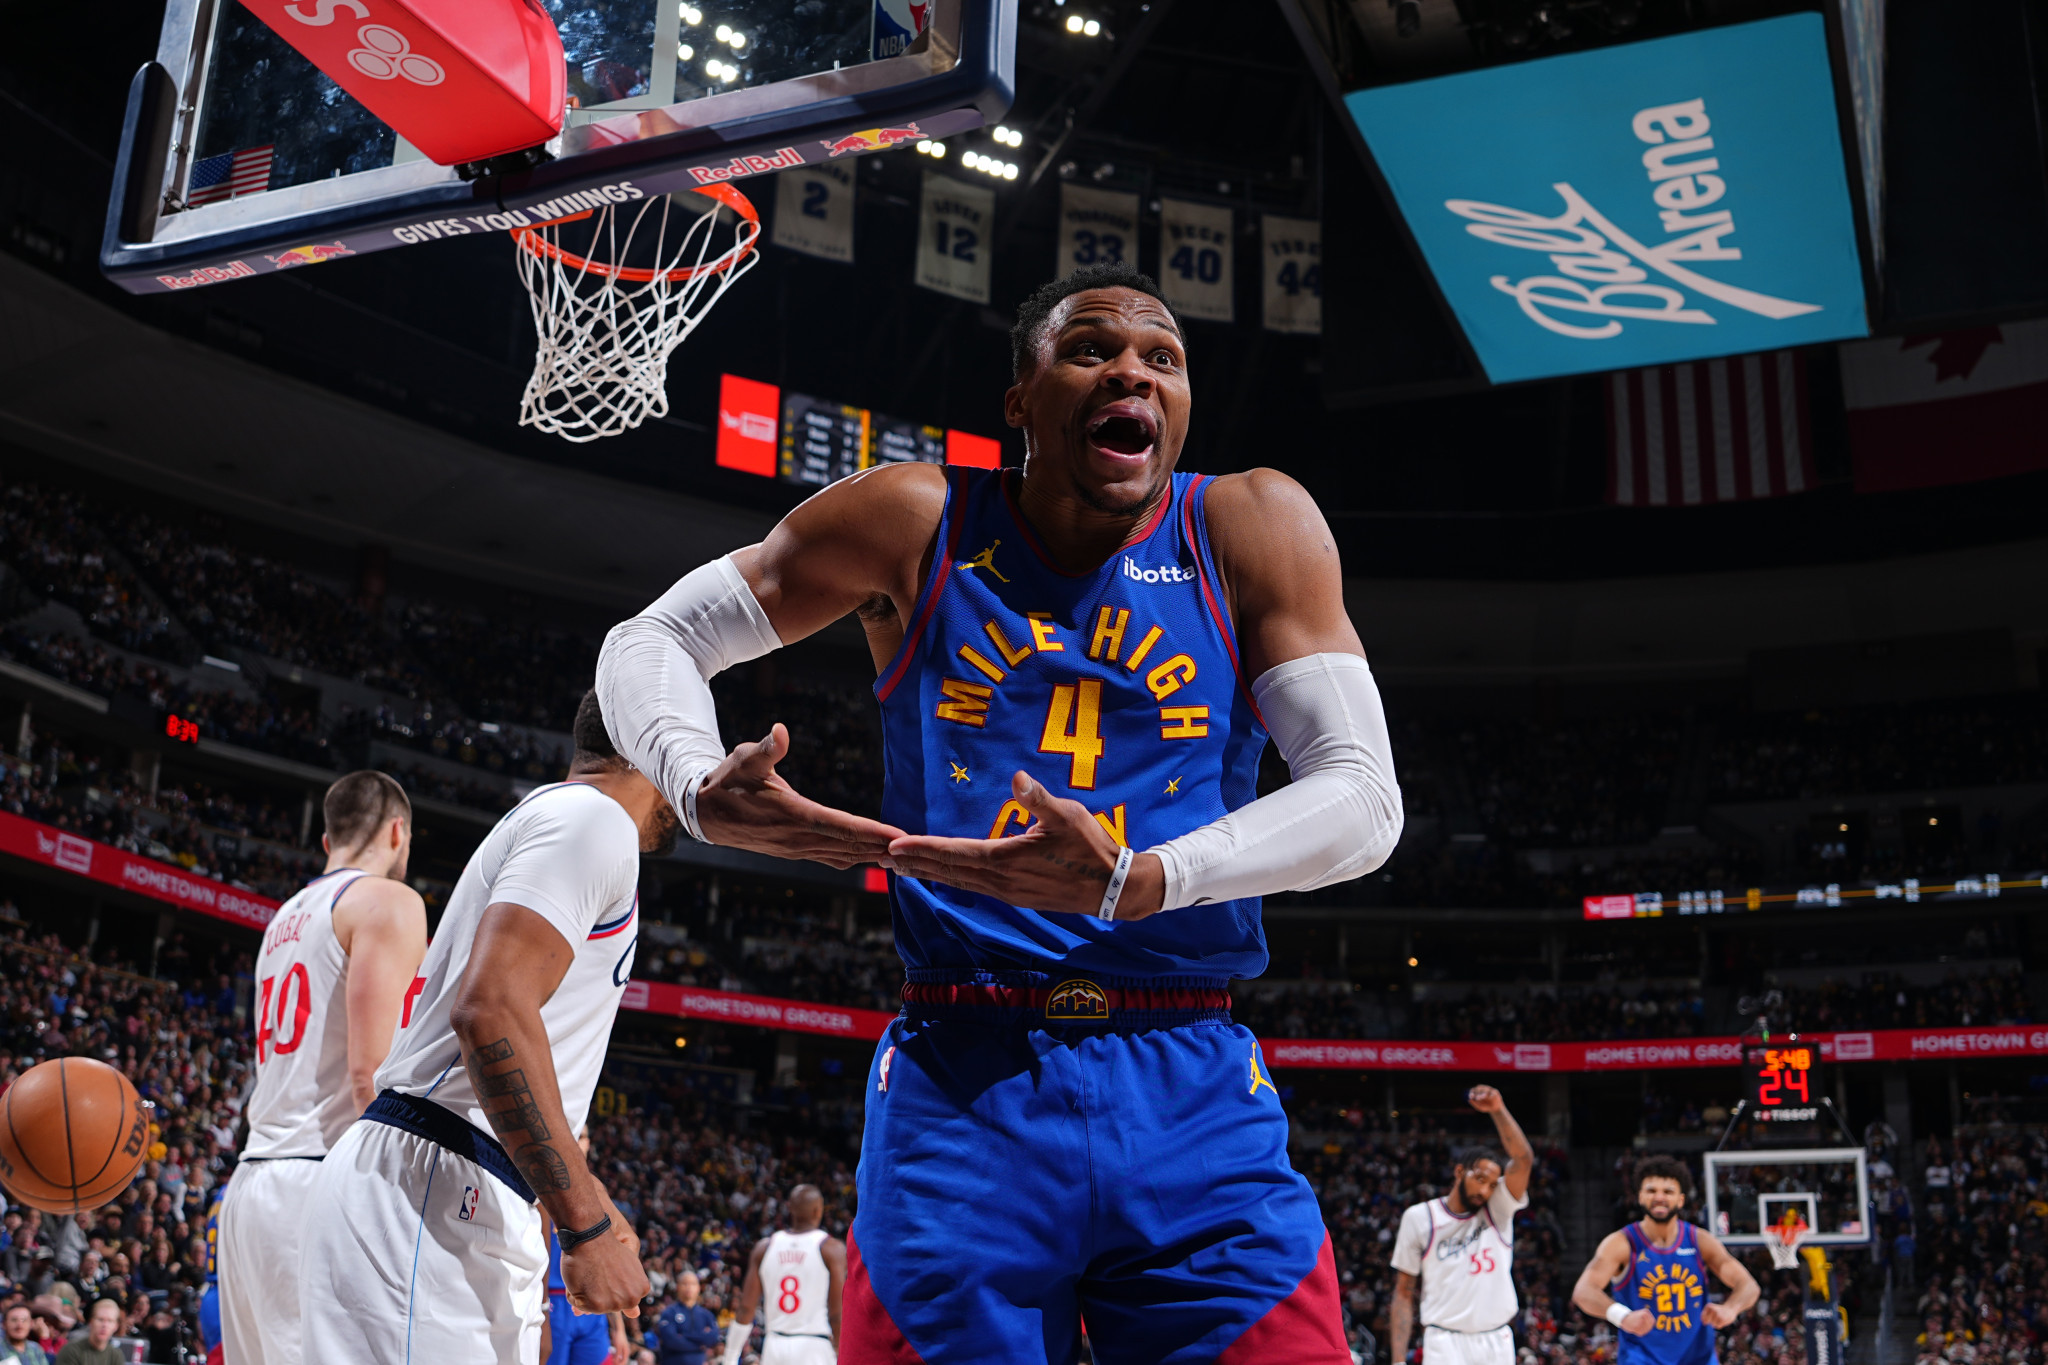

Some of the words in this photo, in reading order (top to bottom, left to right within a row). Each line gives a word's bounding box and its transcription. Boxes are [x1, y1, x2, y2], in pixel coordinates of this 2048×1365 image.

[687, 157, 753, 184] Red
[741, 147, 806, 173] Bull
[1632, 97, 1742, 261] Arena
[392, 217, 472, 244] GIVES
[467, 210, 531, 232] YOU
[527, 181, 644, 221] WIIINGS
[801, 180, 829, 221] 2
[935, 219, 978, 264] 12
[1072, 229, 1124, 266] 33
[1445, 181, 1750, 339] Ball
[156, 269, 214, 290] Red
[200, 260, 257, 282] Bull
[1169, 245, 1222, 285] 40
[1276, 259, 1321, 297] 44
[1124, 555, 1196, 583] ibotta
[935, 612, 1065, 728] MILE
[1088, 605, 1210, 741] HIGH
[1037, 677, 1105, 790] 4
[123, 862, 215, 906] HOMETOWN
[681, 994, 782, 1020] HOMETOWN
[1275, 1046, 1378, 1063] HOMETOWN
[1585, 1046, 1691, 1064] HOMETOWN
[1765, 1049, 1811, 1071] 5:48
[1911, 1032, 2026, 1053] HOMETOWN
[1758, 1070, 1809, 1105] 24
[1470, 1248, 1496, 1275] 55
[778, 1275, 801, 1315] 8
[1638, 1264, 1668, 1299] MILE
[1670, 1263, 1703, 1297] HIGH
[1655, 1282, 1686, 1313] 27
[1655, 1312, 1692, 1333] CITY
